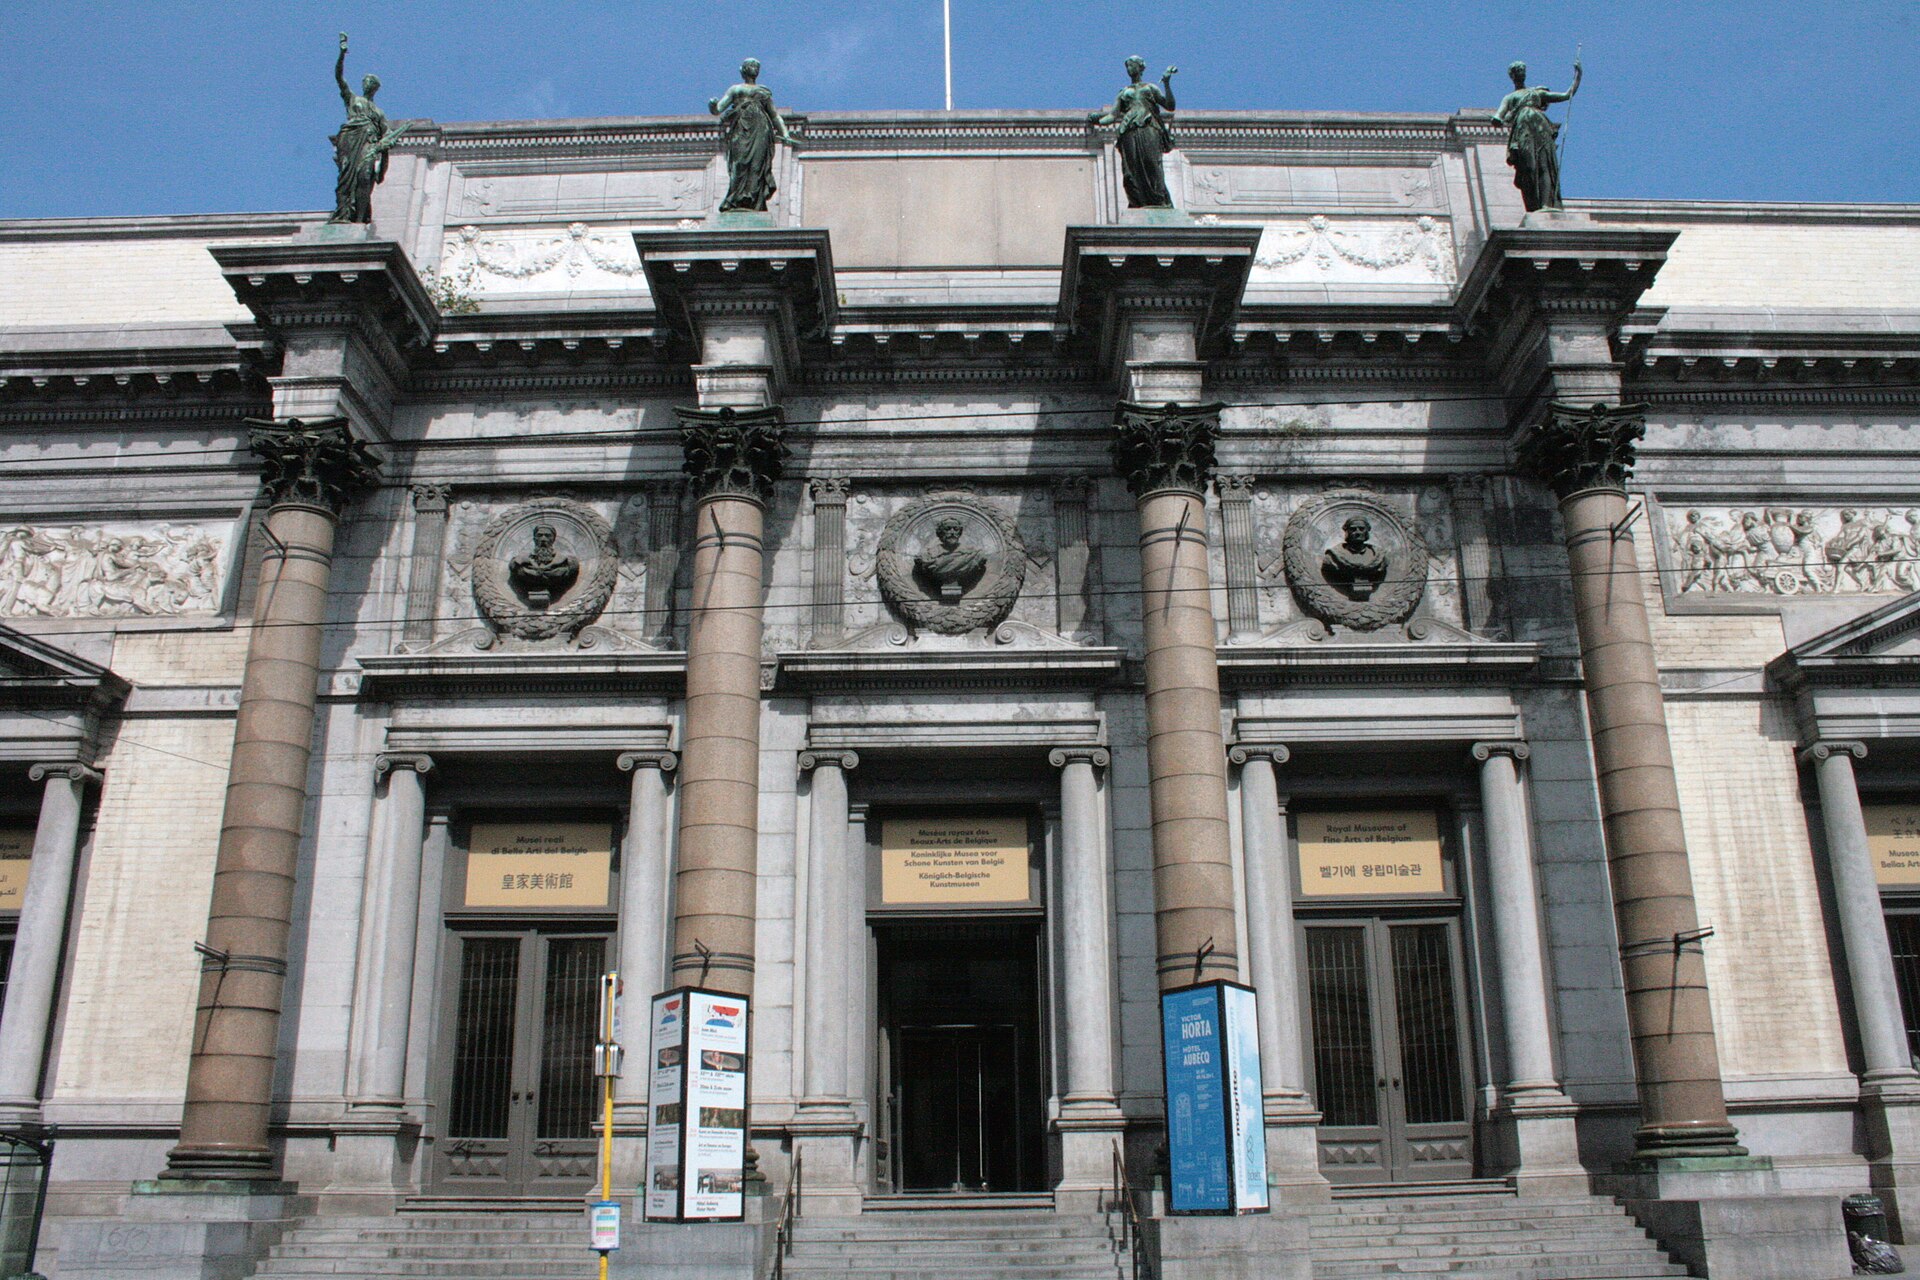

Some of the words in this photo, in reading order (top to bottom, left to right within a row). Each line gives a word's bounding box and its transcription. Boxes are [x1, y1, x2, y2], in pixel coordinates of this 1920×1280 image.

[919, 829, 947, 837] Musées
[948, 829, 974, 838] royaux
[1327, 825, 1351, 834] Royal
[1354, 824, 1395, 832] Museums
[516, 836, 542, 844] Musei
[965, 837, 998, 846] Belgique
[1344, 835, 1362, 843] Arts
[1365, 835, 1374, 843] of
[1376, 835, 1412, 844] Belgium
[491, 847, 499, 855] di
[502, 847, 523, 855] Belle
[560, 847, 588, 856] Belgio
[911, 851, 952, 859] Koninklijke
[981, 858, 1005, 866] België
[1881, 860, 1905, 868] Bellas
[1320, 865, 1356, 878] 벨기에
[1362, 863, 1422, 877] 왕립미술관
[919, 871, 991, 880] Königlich-Belgische
[501, 873, 574, 890] 皇家美術館
[1181, 1013, 1202, 1022] VICTOR
[1181, 1020, 1213, 1039] HORTA
[1183, 1051, 1210, 1066] AUBECQ
[1233, 1070, 1241, 1136] magritte
